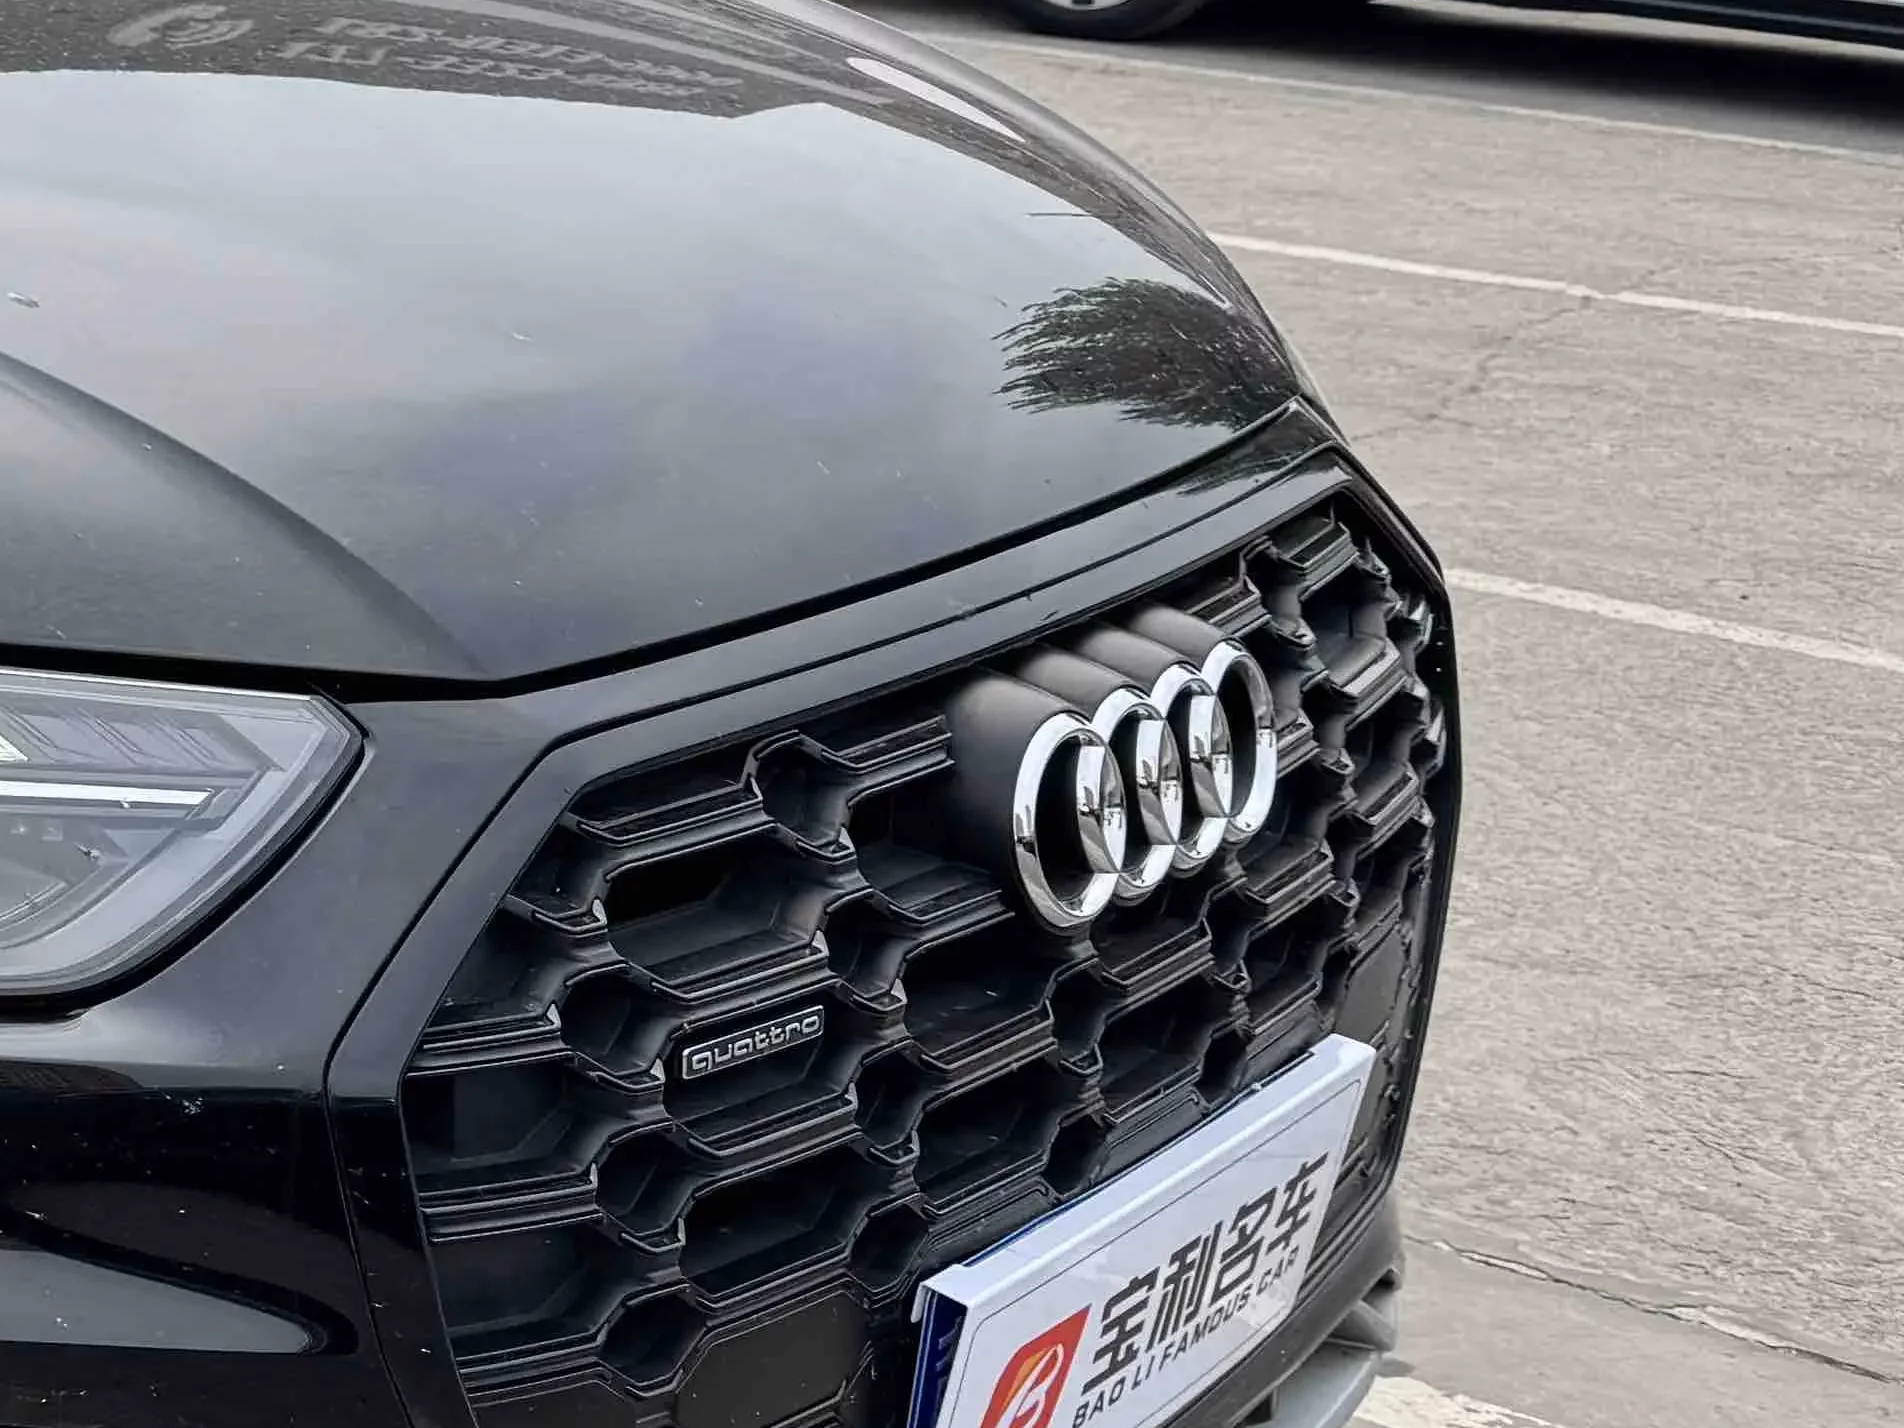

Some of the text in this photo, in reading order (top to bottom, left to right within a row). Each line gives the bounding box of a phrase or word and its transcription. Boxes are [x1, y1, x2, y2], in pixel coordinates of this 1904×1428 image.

[692, 1015, 819, 1071] quattro
[1081, 1152, 1329, 1396] 宝利名车
[1131, 1355, 1156, 1391] LI
[1159, 1283, 1253, 1372] FAMOUS
[1256, 1244, 1301, 1297] CAR
